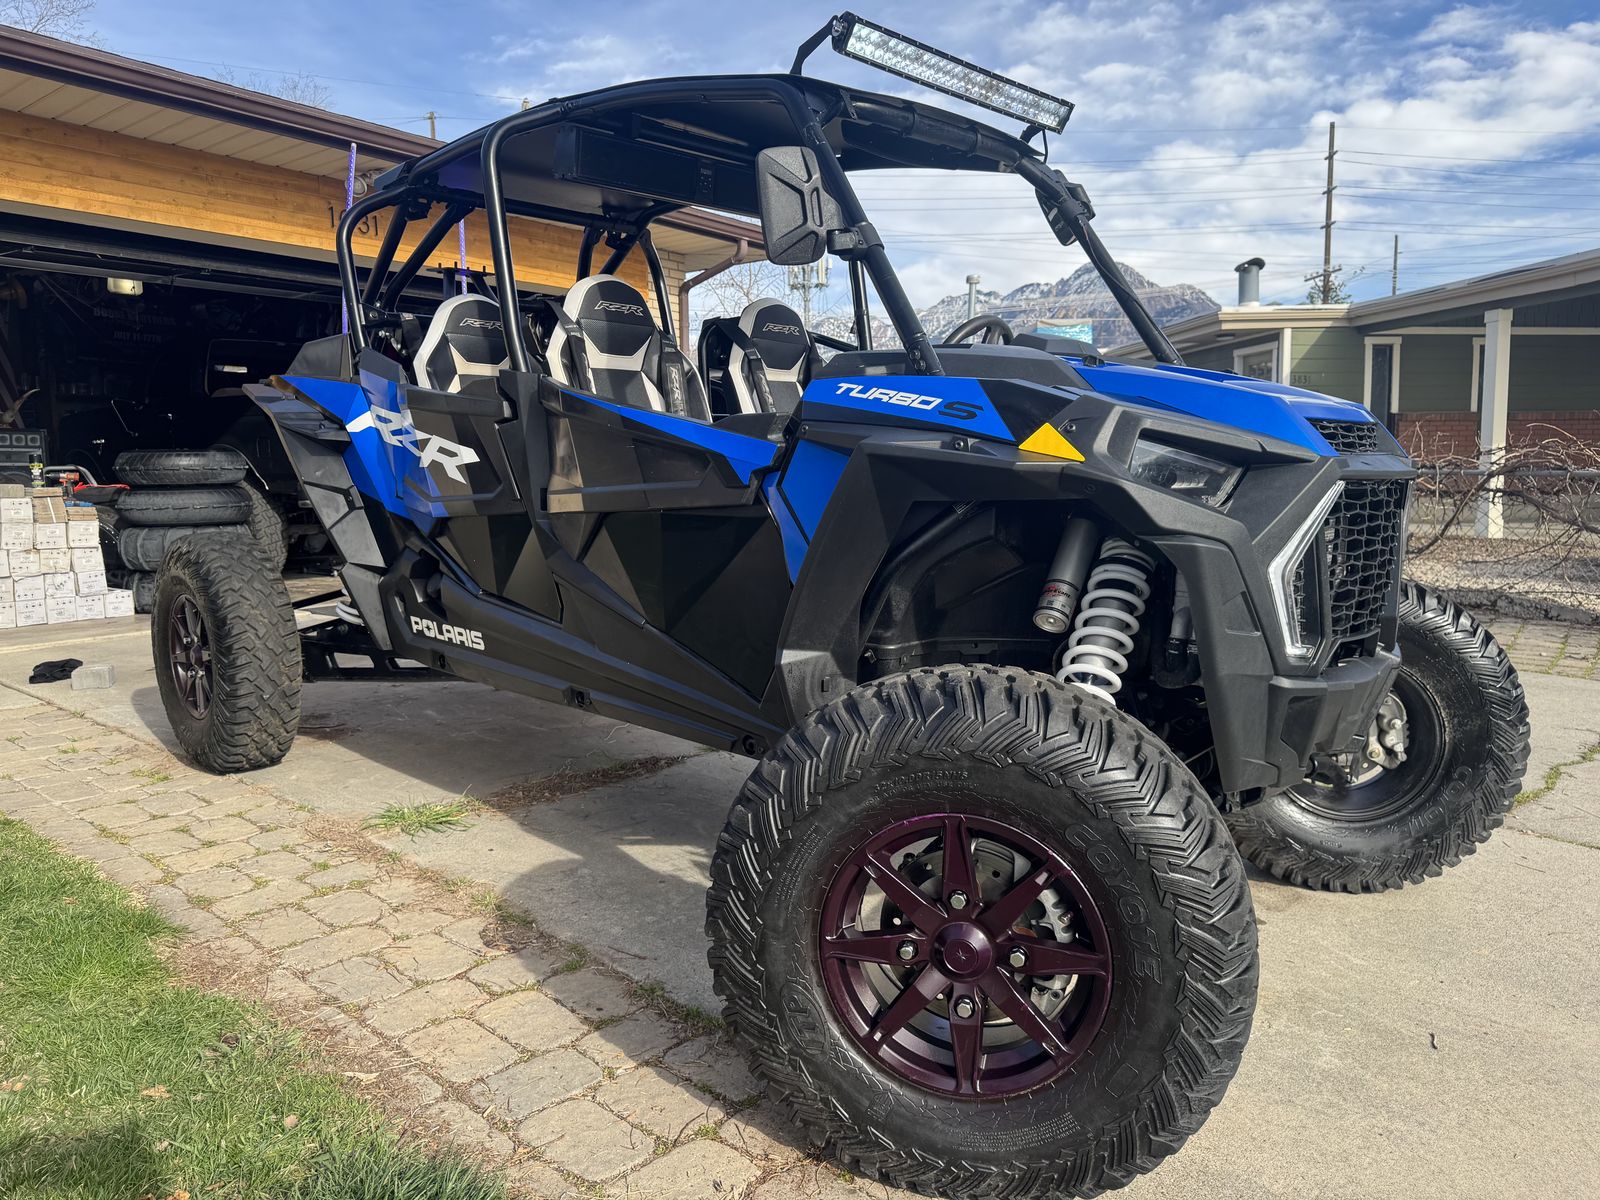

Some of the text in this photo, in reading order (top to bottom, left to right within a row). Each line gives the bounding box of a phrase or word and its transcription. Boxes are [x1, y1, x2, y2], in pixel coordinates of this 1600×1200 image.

[594, 300, 644, 317] RZR
[762, 323, 800, 336] RZR
[835, 382, 984, 420] TURBO S
[345, 404, 480, 485] RZR
[410, 615, 485, 651] POLARIS
[1064, 823, 1163, 985] COYOTE
[782, 992, 827, 1052] ITP
